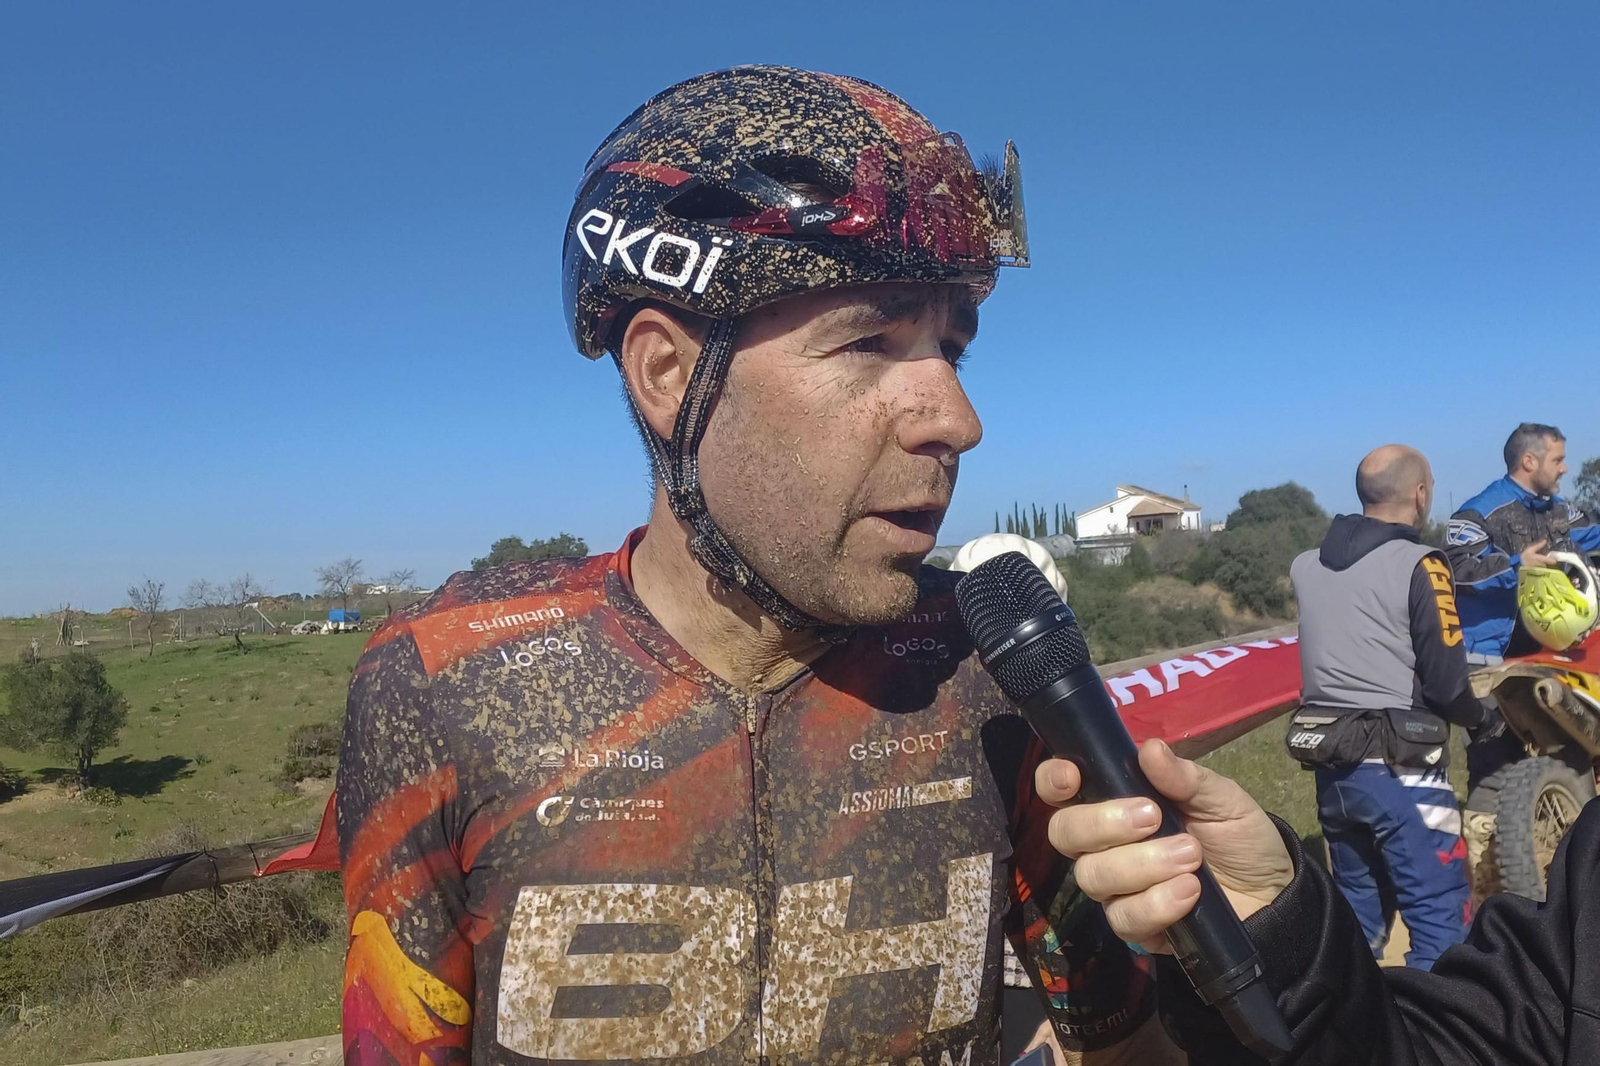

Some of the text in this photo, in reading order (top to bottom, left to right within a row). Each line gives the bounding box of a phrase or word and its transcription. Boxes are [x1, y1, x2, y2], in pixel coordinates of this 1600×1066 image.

[1422, 556, 1464, 648] STAFF
[468, 607, 565, 633] SHIMANO
[500, 637, 582, 668] LOGOS
[849, 731, 949, 762] GSPORT
[1290, 732, 1326, 746] UFO
[574, 748, 665, 772] La Rioja
[495, 852, 993, 1061] BH
